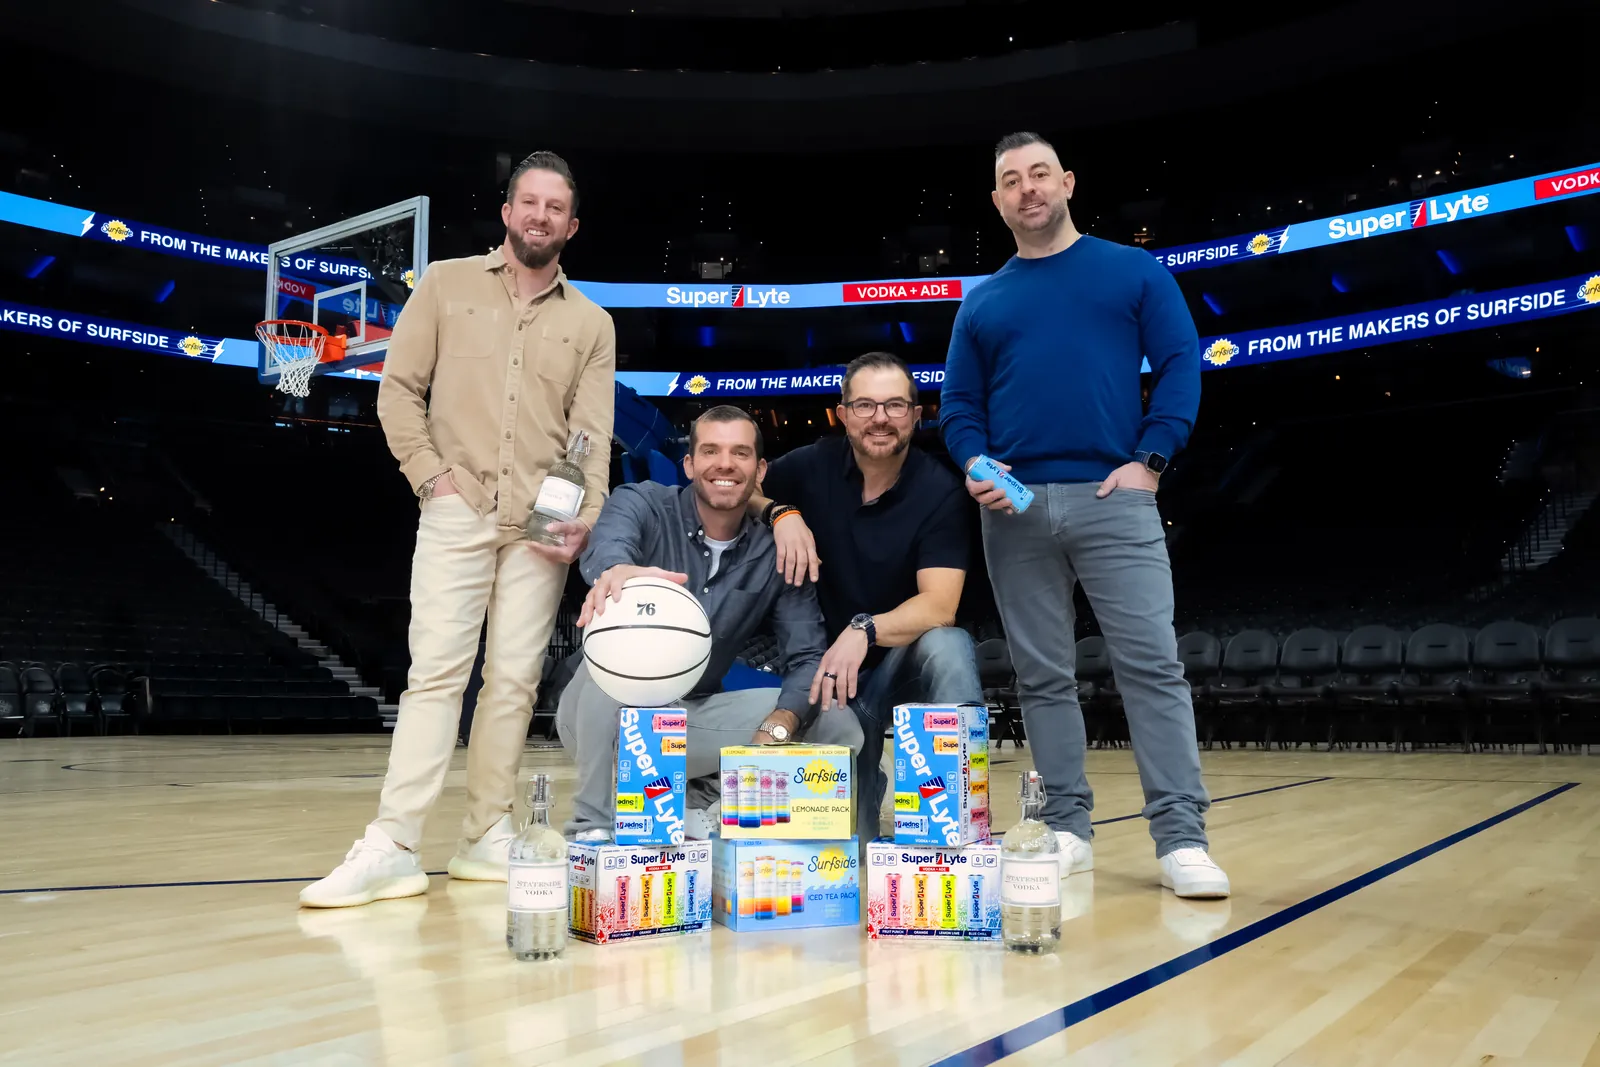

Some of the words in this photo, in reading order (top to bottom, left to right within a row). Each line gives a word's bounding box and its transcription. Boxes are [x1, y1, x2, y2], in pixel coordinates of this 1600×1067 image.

[1328, 210, 1406, 239] Super
[1430, 194, 1489, 222] Lyte
[101, 222, 133, 238] Surfside
[140, 230, 186, 251] FROM
[191, 241, 221, 258] THE
[225, 247, 291, 268] MAKES
[295, 258, 316, 271] OF
[1246, 238, 1275, 252] Surfside
[1167, 243, 1239, 267] SURFSIDE
[666, 286, 729, 308] Super
[746, 286, 790, 307] Lyte
[857, 285, 906, 299] VODKA
[909, 287, 918, 296] +
[920, 284, 949, 297] ADE
[0, 309, 53, 329] KERS
[58, 319, 83, 333] OF
[86, 323, 169, 348] SURFSIDE
[1248, 334, 1302, 356] FROM
[1307, 327, 1343, 347] THE
[1349, 312, 1430, 340] MAKERS
[1435, 307, 1462, 325] OF
[1467, 289, 1566, 321] SURFSIDE
[177, 338, 208, 353] Surfside
[1203, 343, 1239, 362] Surfside
[716, 378, 757, 390] FROM
[760, 376, 787, 388] THE
[790, 375, 842, 388] MAKER
[986, 461, 1001, 475] Lyte
[1004, 476, 1025, 494] Super
[636, 603, 656, 616] 76
[620, 708, 659, 777] Super
[654, 793, 685, 845] Lyte
[793, 767, 848, 784] Surfside
[894, 708, 932, 777] Super
[928, 793, 960, 846] Lyte
[569, 854, 580, 864] uper
[584, 855, 595, 867] Lyte
[630, 854, 659, 866] Super
[666, 852, 685, 863] Lyte
[808, 855, 857, 872] Surfside
[901, 853, 934, 865] Super
[944, 853, 967, 865] Lyte
[517, 879, 562, 888] STATESIDE
[1006, 874, 1049, 882] STATESIDE
